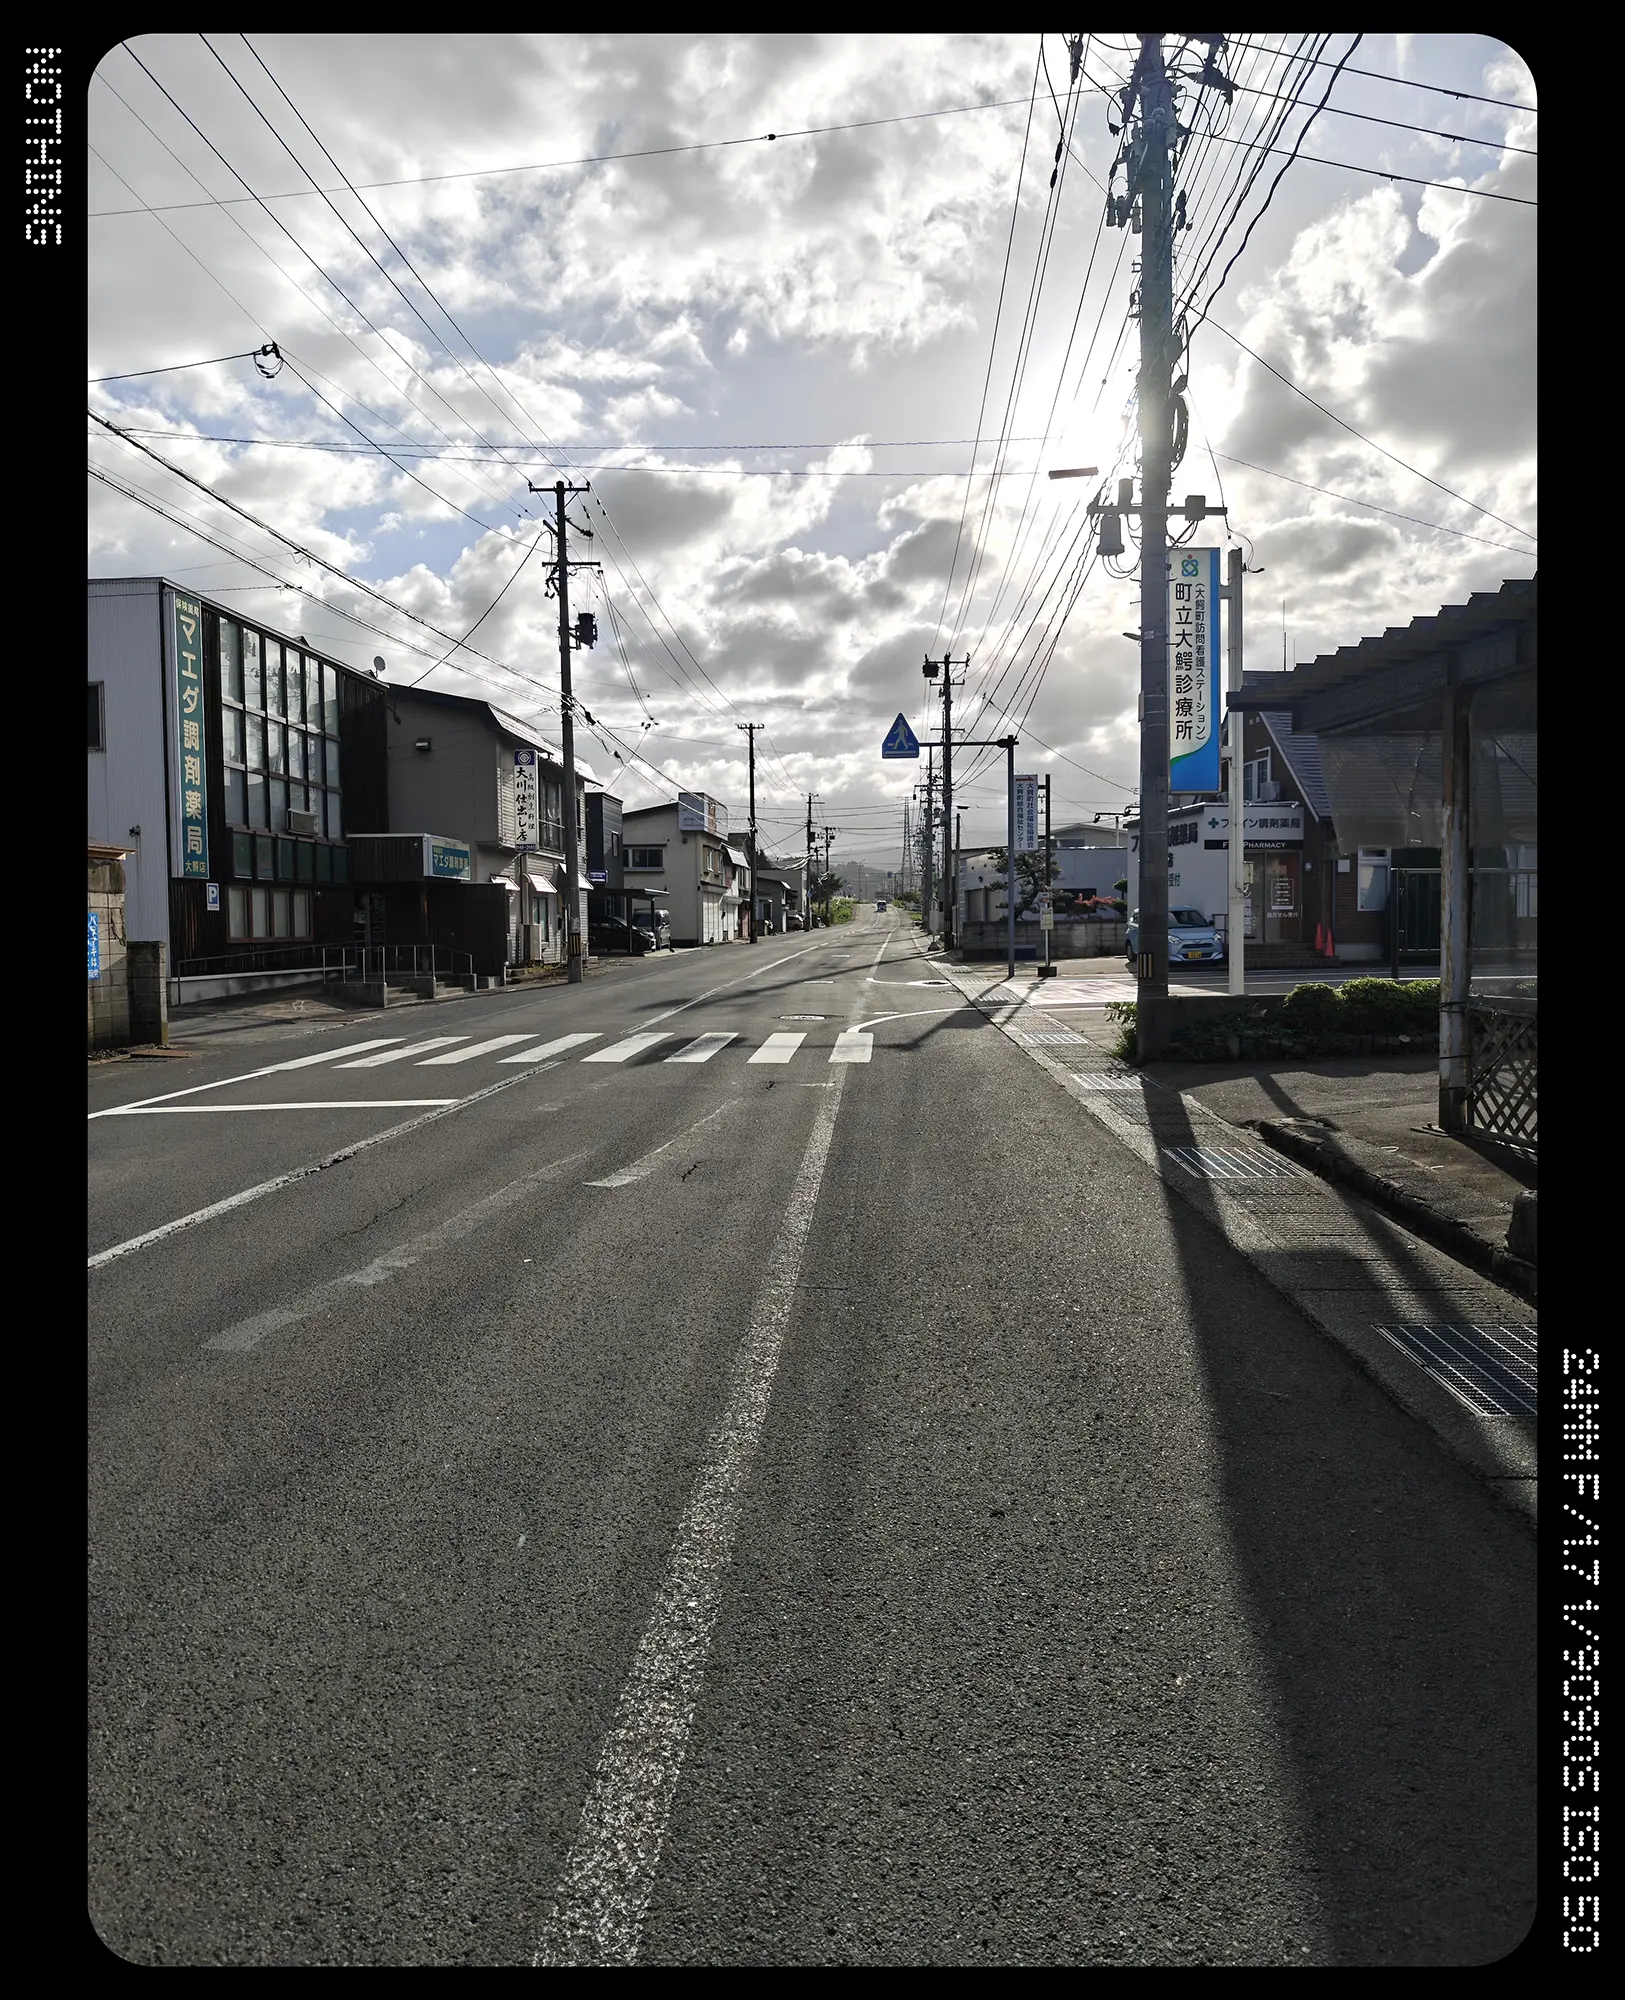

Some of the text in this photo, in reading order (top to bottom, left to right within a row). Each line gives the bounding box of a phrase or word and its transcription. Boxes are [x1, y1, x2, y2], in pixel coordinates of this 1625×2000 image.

[1175, 583, 1193, 739] 町立大鰐診療所
[180, 614, 202, 855] マエダ調剤薬局
[516, 767, 528, 841] 大川仕出し店
[208, 886, 217, 903] P
